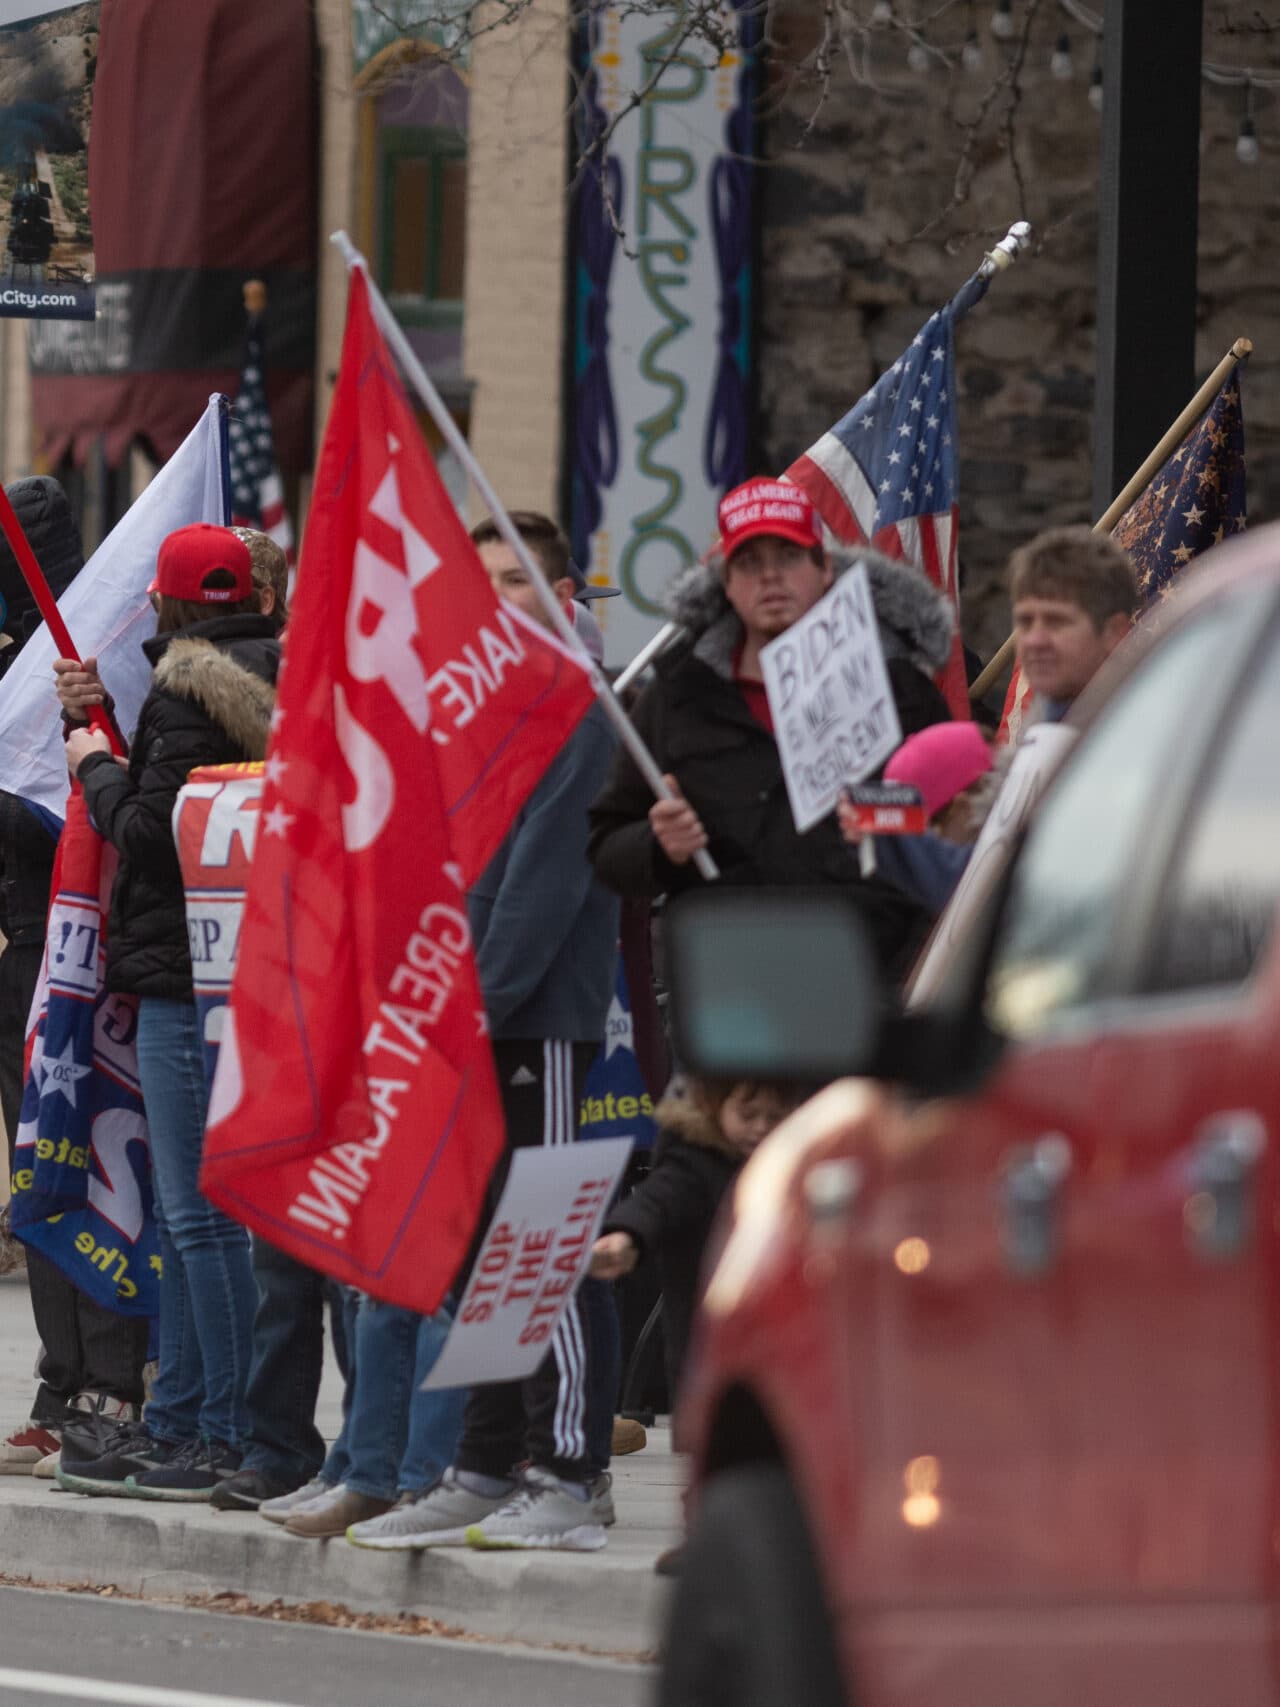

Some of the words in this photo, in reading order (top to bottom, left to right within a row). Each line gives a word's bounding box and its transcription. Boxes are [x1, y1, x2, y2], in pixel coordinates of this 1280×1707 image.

[773, 580, 867, 713] BIDEN
[460, 1221, 517, 1326] STOP
[502, 1228, 558, 1306] THE
